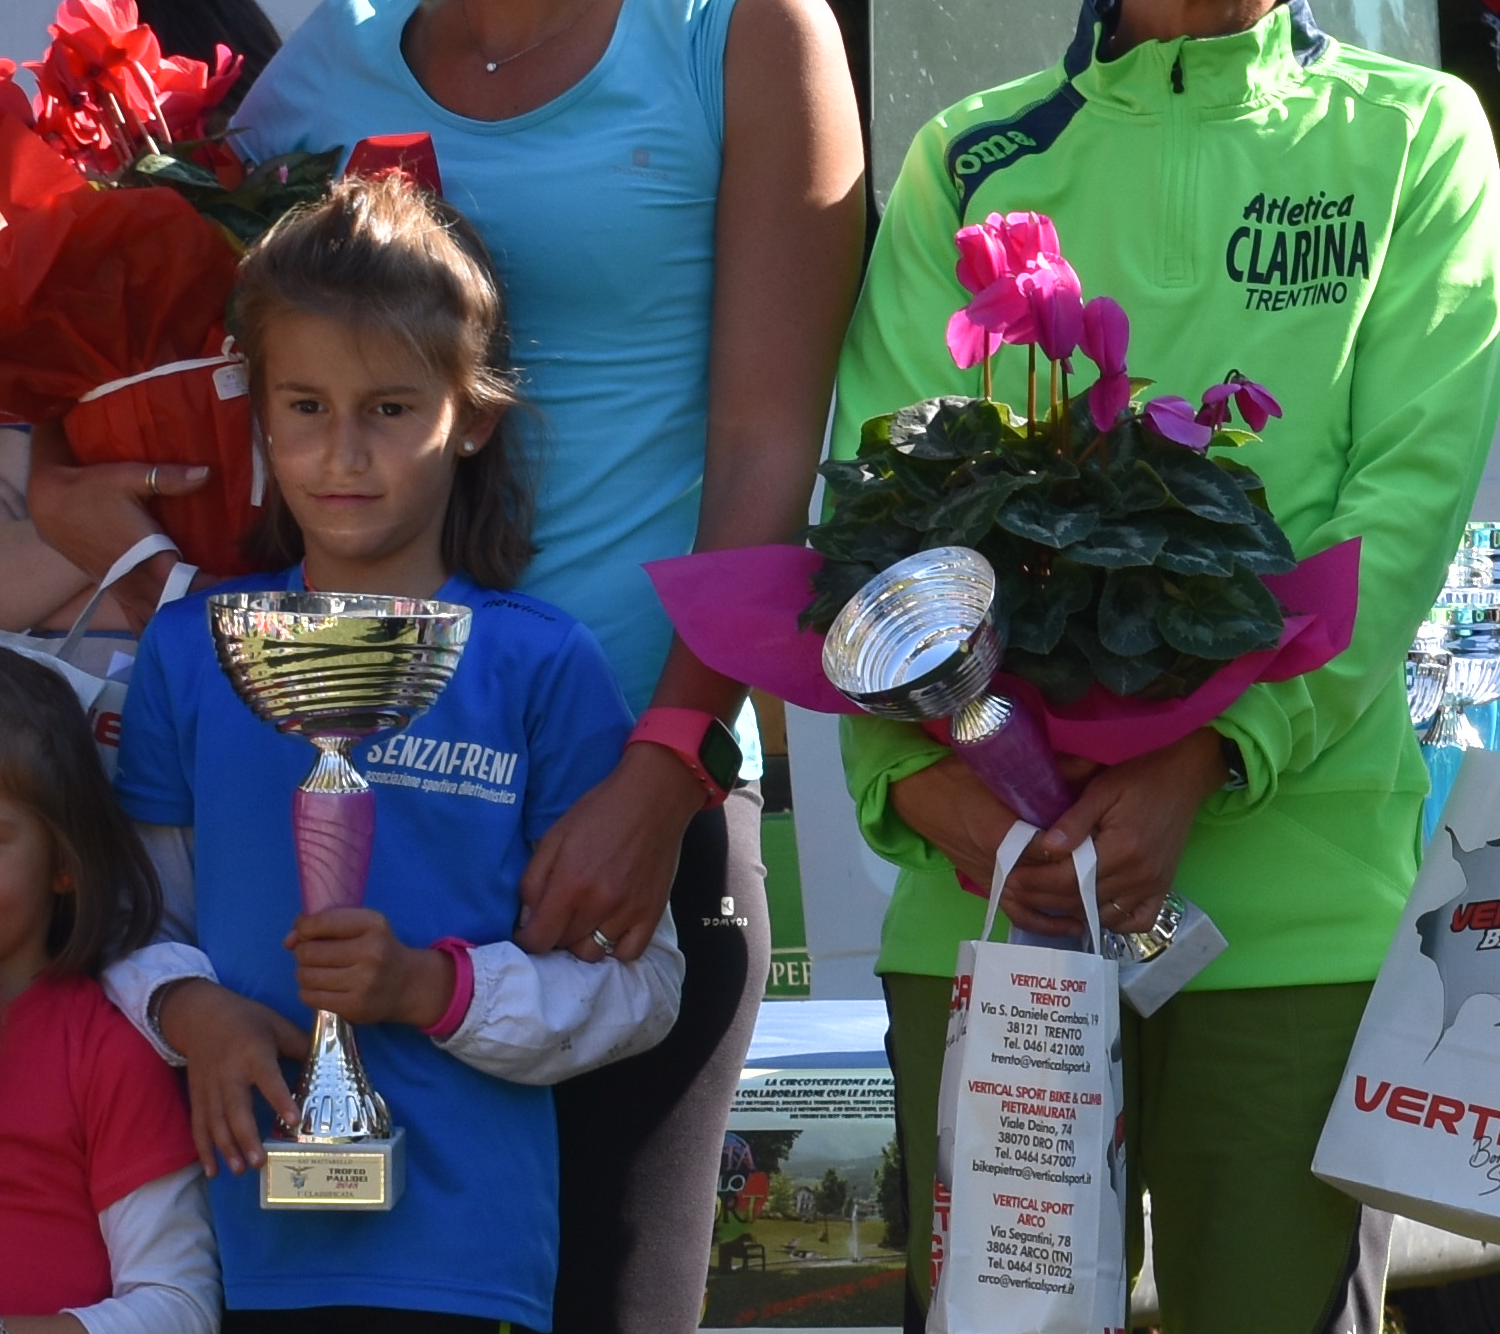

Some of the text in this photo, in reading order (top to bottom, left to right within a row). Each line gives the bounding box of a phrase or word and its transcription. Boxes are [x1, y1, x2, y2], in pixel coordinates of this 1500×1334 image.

[1242, 190, 1355, 227] Atletica
[1225, 220, 1370, 286] CLARINA
[1245, 281, 1348, 312] TRENTINO
[367, 734, 518, 785] SENZAFRENI
[364, 770, 421, 788] associazione
[422, 778, 457, 794] sportiva
[1010, 972, 1087, 993] VERTICAL SPORT
[1030, 991, 1071, 1008] TRENTO
[980, 1001, 997, 1015] Via
[999, 1004, 1008, 1017] S.
[1011, 1005, 1049, 1022] Daniele
[1091, 1013, 1099, 1025] 19
[1007, 1021, 1082, 1040] 38121 TRENTO
[1003, 1037, 1085, 1057] Tel. 0461 421000
[991, 1052, 1091, 1074] trento@verticalsport.it
[968, 1080, 1014, 1097] VERTICAL
[1016, 1086, 1047, 1100] SPORT
[1049, 1090, 1071, 1103] BIKE
[1072, 1093, 1079, 1103] &
[1001, 1100, 1077, 1120] PIETRAMURATA
[1000, 1116, 1073, 1136] Viale Daino, 74
[998, 1131, 1030, 1146] 38070
[1033, 1136, 1053, 1150] DRO
[994, 1147, 1076, 1167] Tel. 0464 547007
[972, 1160, 1092, 1185] bikepietra@verticalsport.it
[993, 1193, 1074, 1216] VERTICAL SPORT
[1017, 1213, 1046, 1228] ARCO
[991, 1225, 1071, 1248] Via Segantini, 78
[986, 1241, 1073, 1265] 38062 ARCO (TN)
[988, 1257, 1072, 1278] Tel. 0464 510202
[978, 1273, 1075, 1295] arco@verticalsport.it
